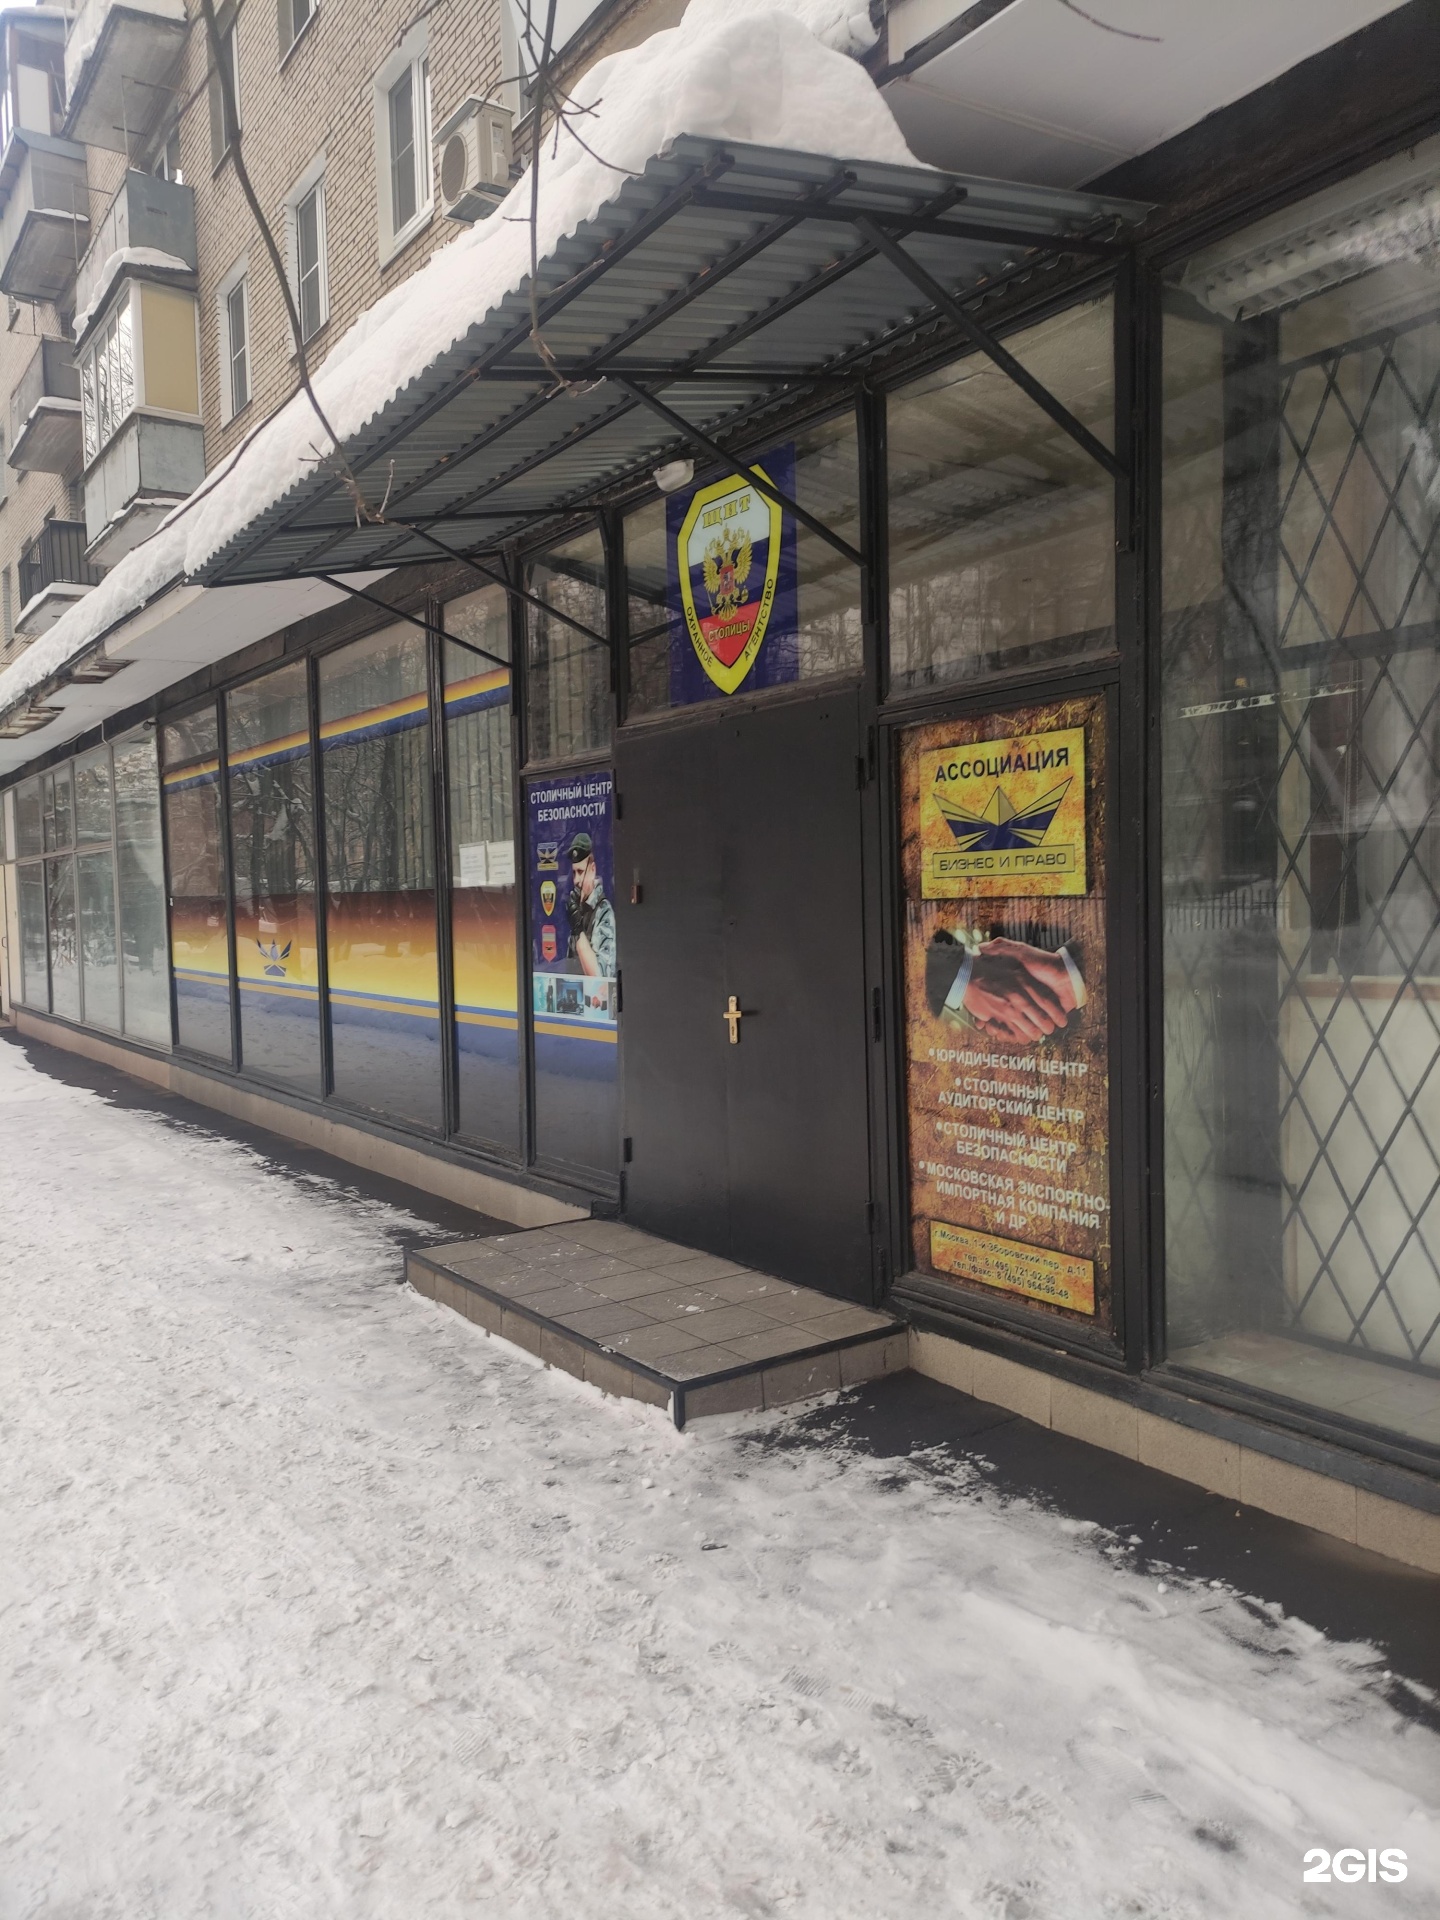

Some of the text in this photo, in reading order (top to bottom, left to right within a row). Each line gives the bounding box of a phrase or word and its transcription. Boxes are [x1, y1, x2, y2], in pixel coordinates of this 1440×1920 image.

[702, 494, 750, 529] ЩИТ
[686, 578, 774, 668] ОХРАННОЕ АГЕНТСТВО
[708, 620, 750, 642] СТОЛИЦЫ
[935, 747, 1069, 783] АССОЦИАЦИЯ
[530, 781, 613, 804] СТОЛИЧНЫЙ ЦЕНТР
[537, 801, 606, 822] БЕЗОПАСНОСТИ
[939, 852, 1067, 871] БИЗНЕС И ПРАВО
[936, 1049, 1088, 1077] ЮРИДИЧЕСКИЙ ЦЕНТР
[963, 1078, 1049, 1101] СТОЛИЧНЫЙ
[938, 1092, 1085, 1124] АУДИТОРСКИЙ ЦЕНТР
[944, 1122, 1077, 1156] СТОЛИЧНЫЙ ЦЕНТР
[956, 1141, 1068, 1174] БЕЗОПАСНОСТИ
[927, 1162, 1015, 1192] МОСКОВСКАЯ
[936, 1181, 1101, 1229] ИМПОРТНАЯ КОМПАНИЯ
[996, 1210, 1005, 1224] И
